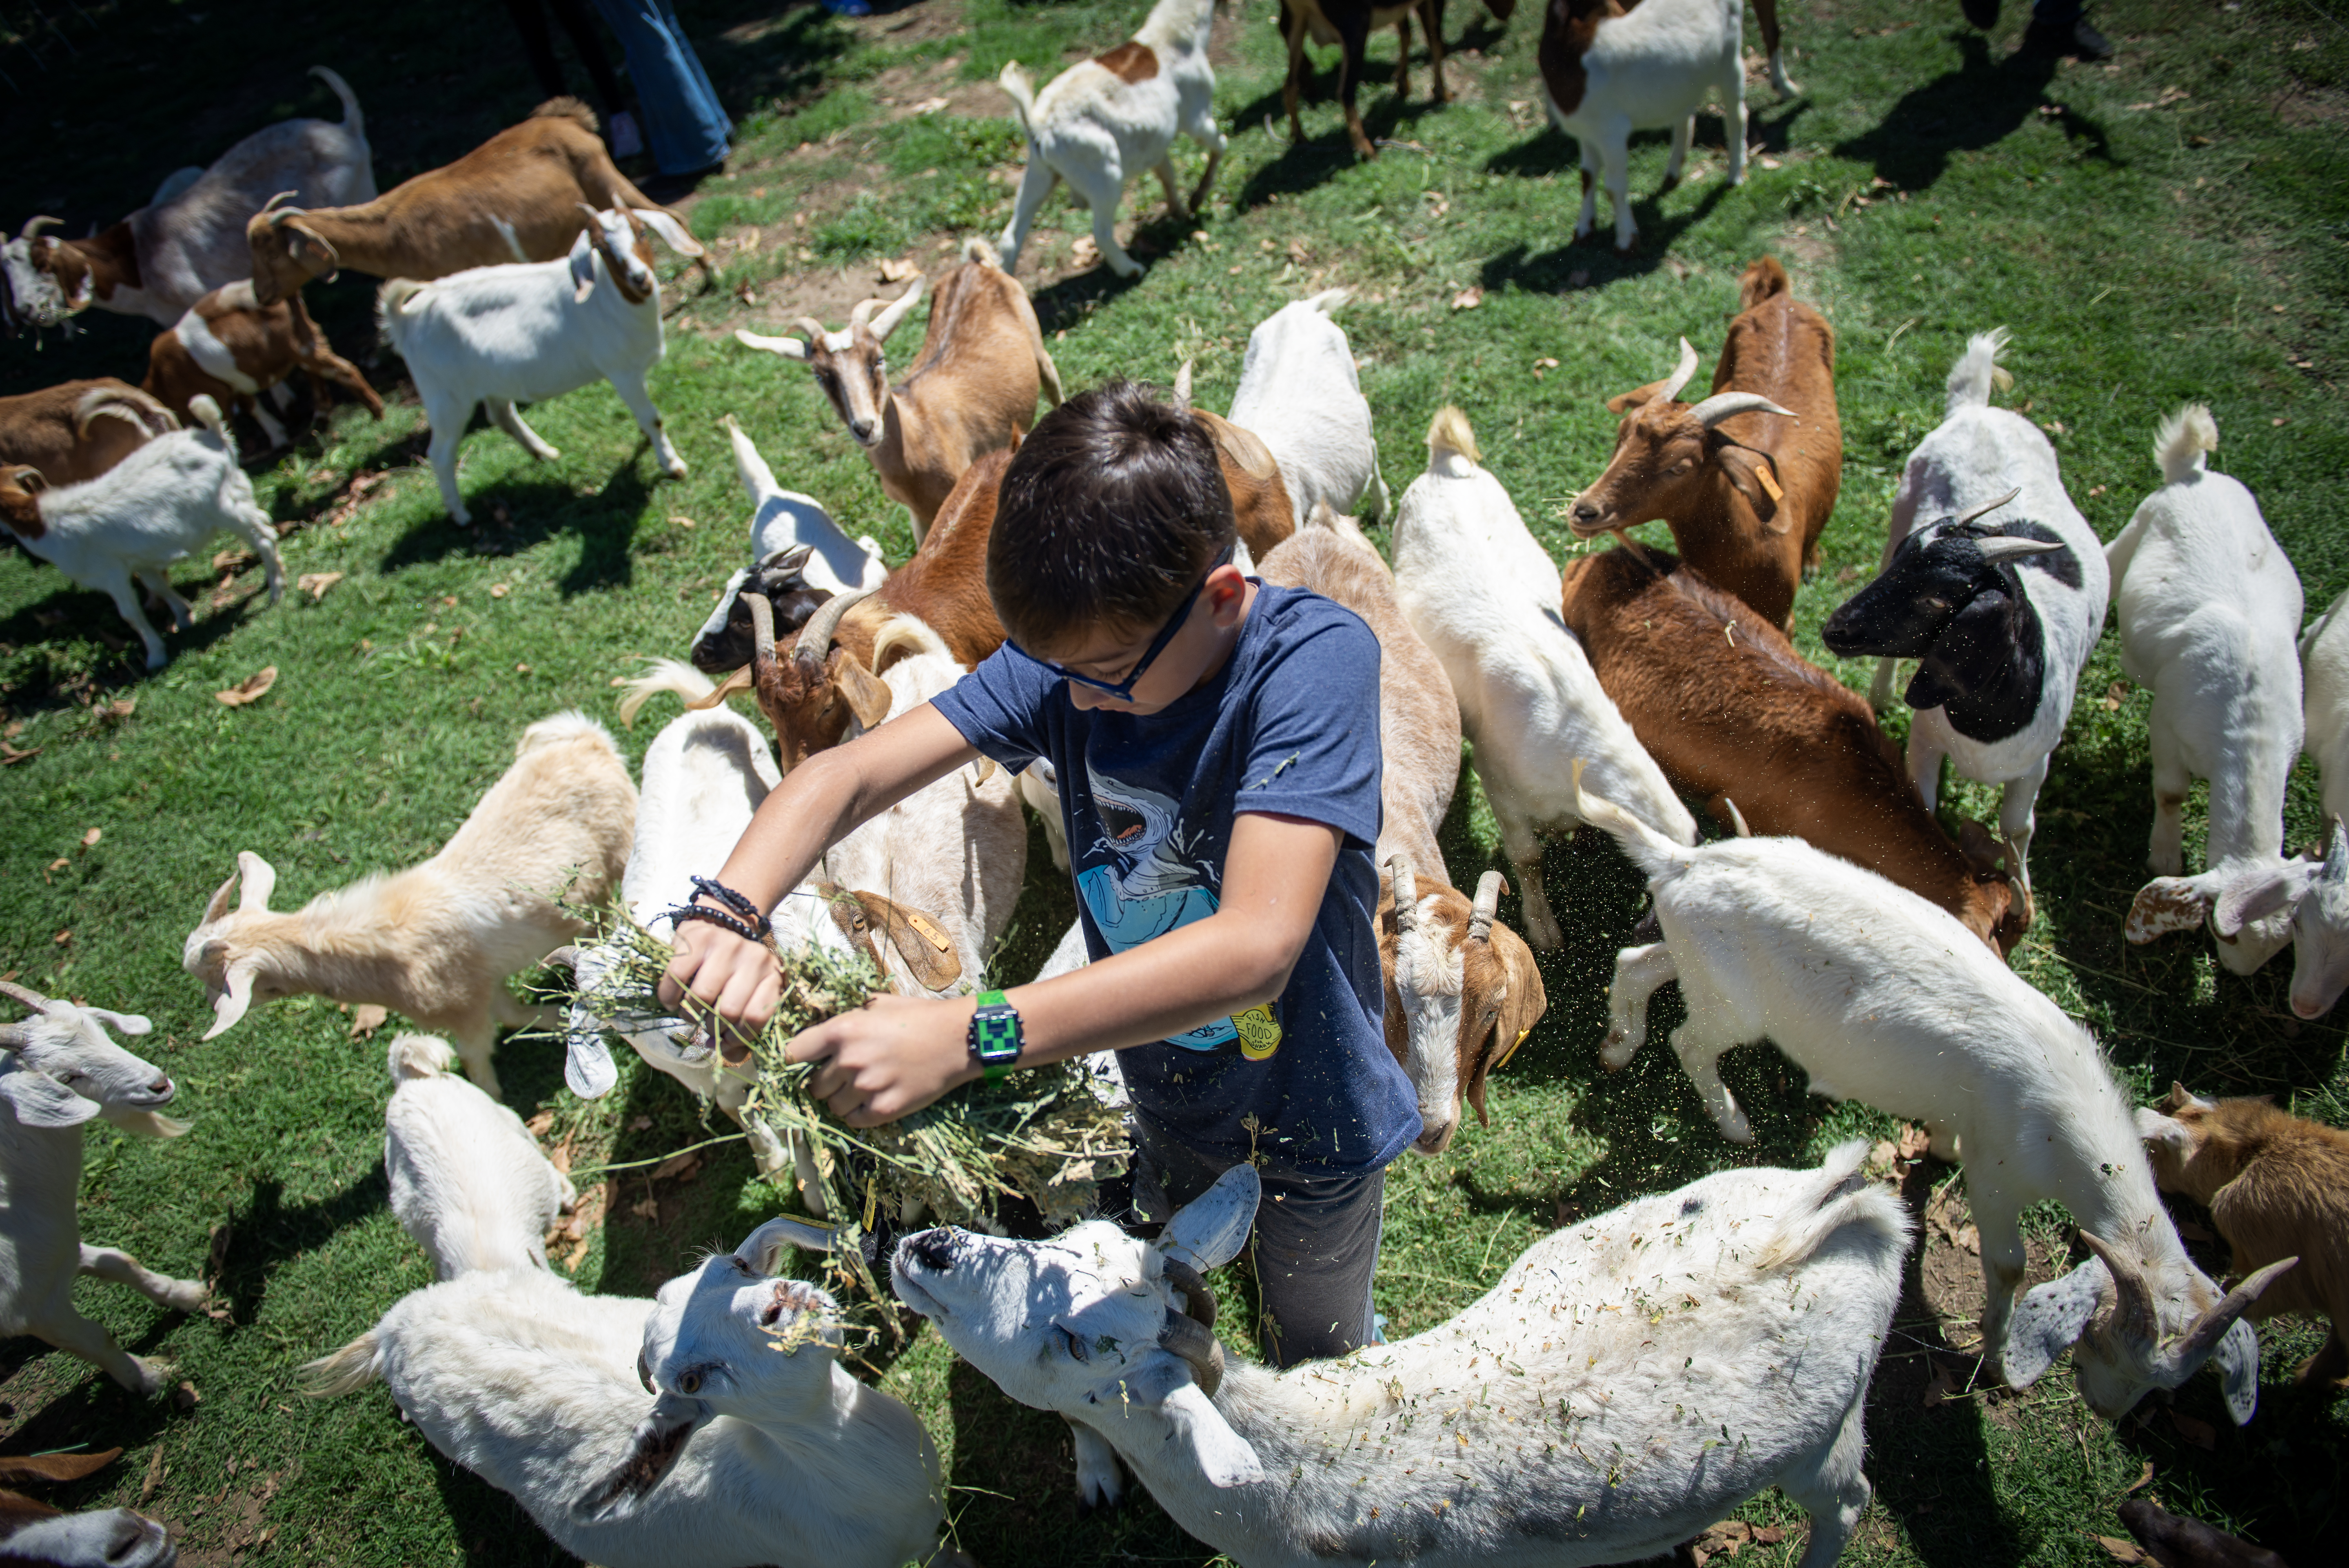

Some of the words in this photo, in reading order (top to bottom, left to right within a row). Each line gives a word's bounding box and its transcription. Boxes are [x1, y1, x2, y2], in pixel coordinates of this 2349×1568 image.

[924, 928, 940, 940] 65
[1247, 1014, 1265, 1023] FISH
[1247, 1023, 1272, 1039] FOOD
